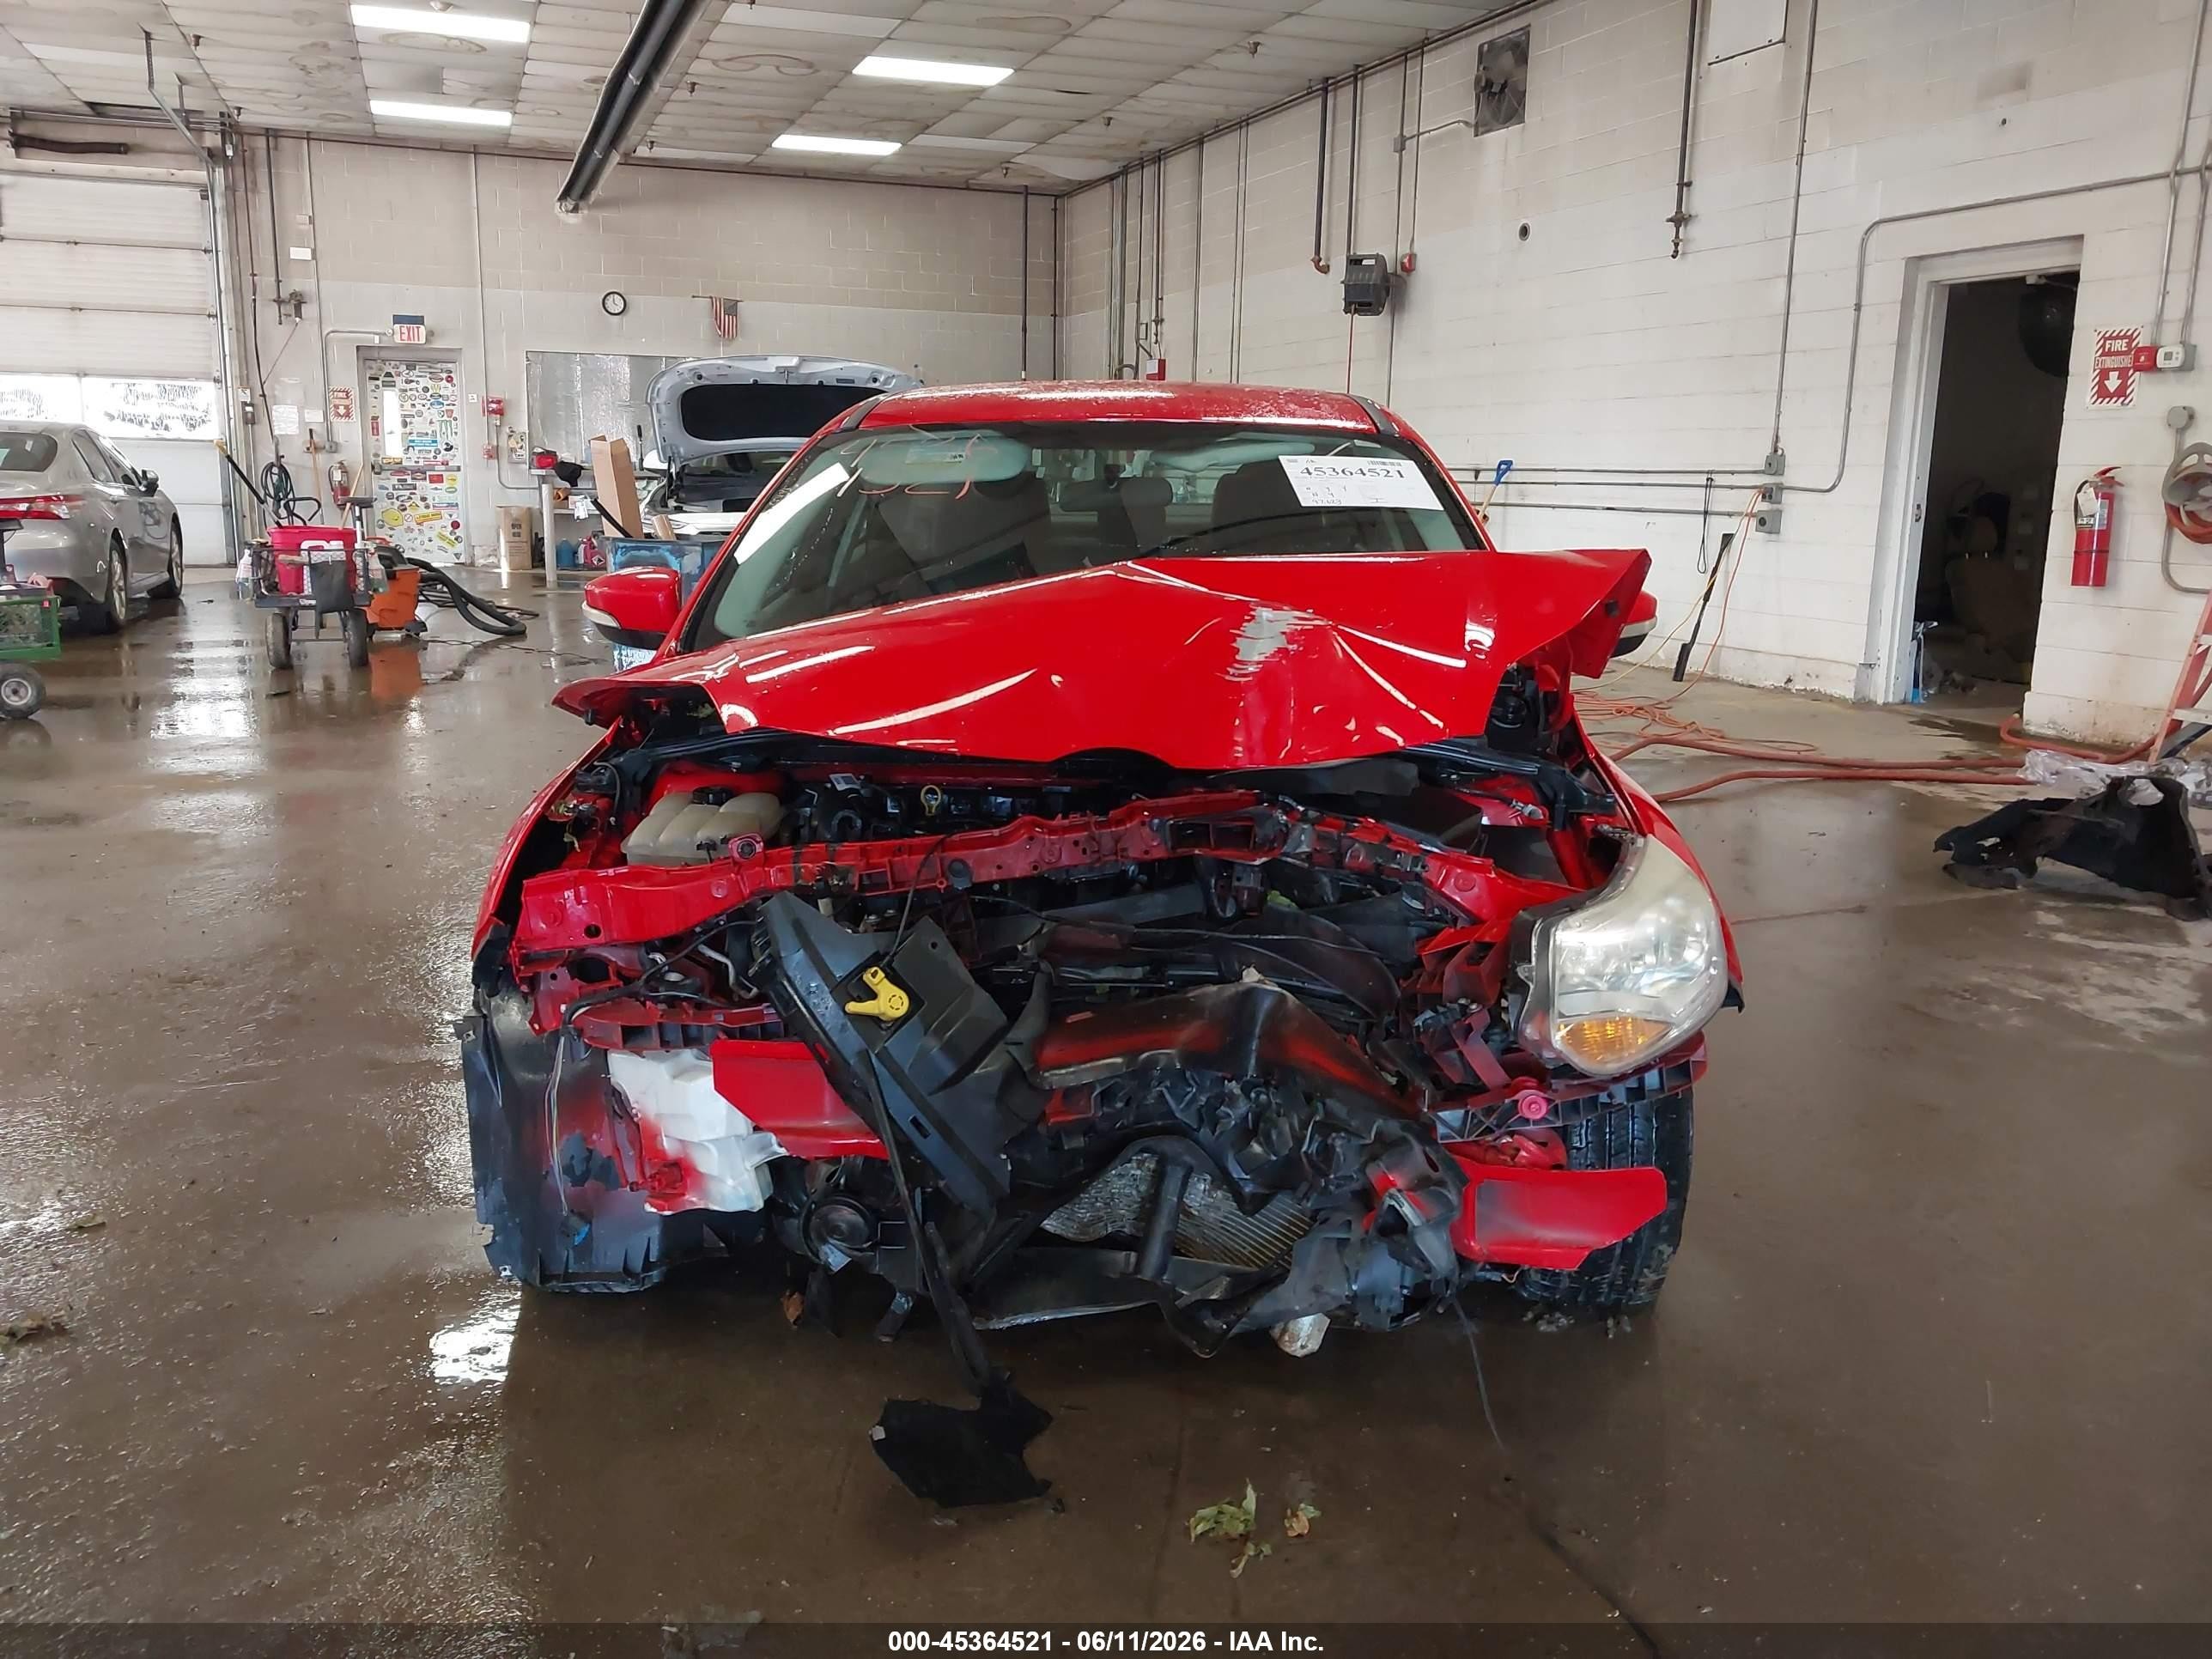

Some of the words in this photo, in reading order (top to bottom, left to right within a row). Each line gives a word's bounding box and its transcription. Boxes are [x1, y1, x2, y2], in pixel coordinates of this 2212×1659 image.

[399, 325, 421, 342] EXIT
[2105, 339, 2129, 352] FIRE
[2094, 355, 2134, 369] EXTINGUISHE
[1300, 466, 1405, 479] 45364521
